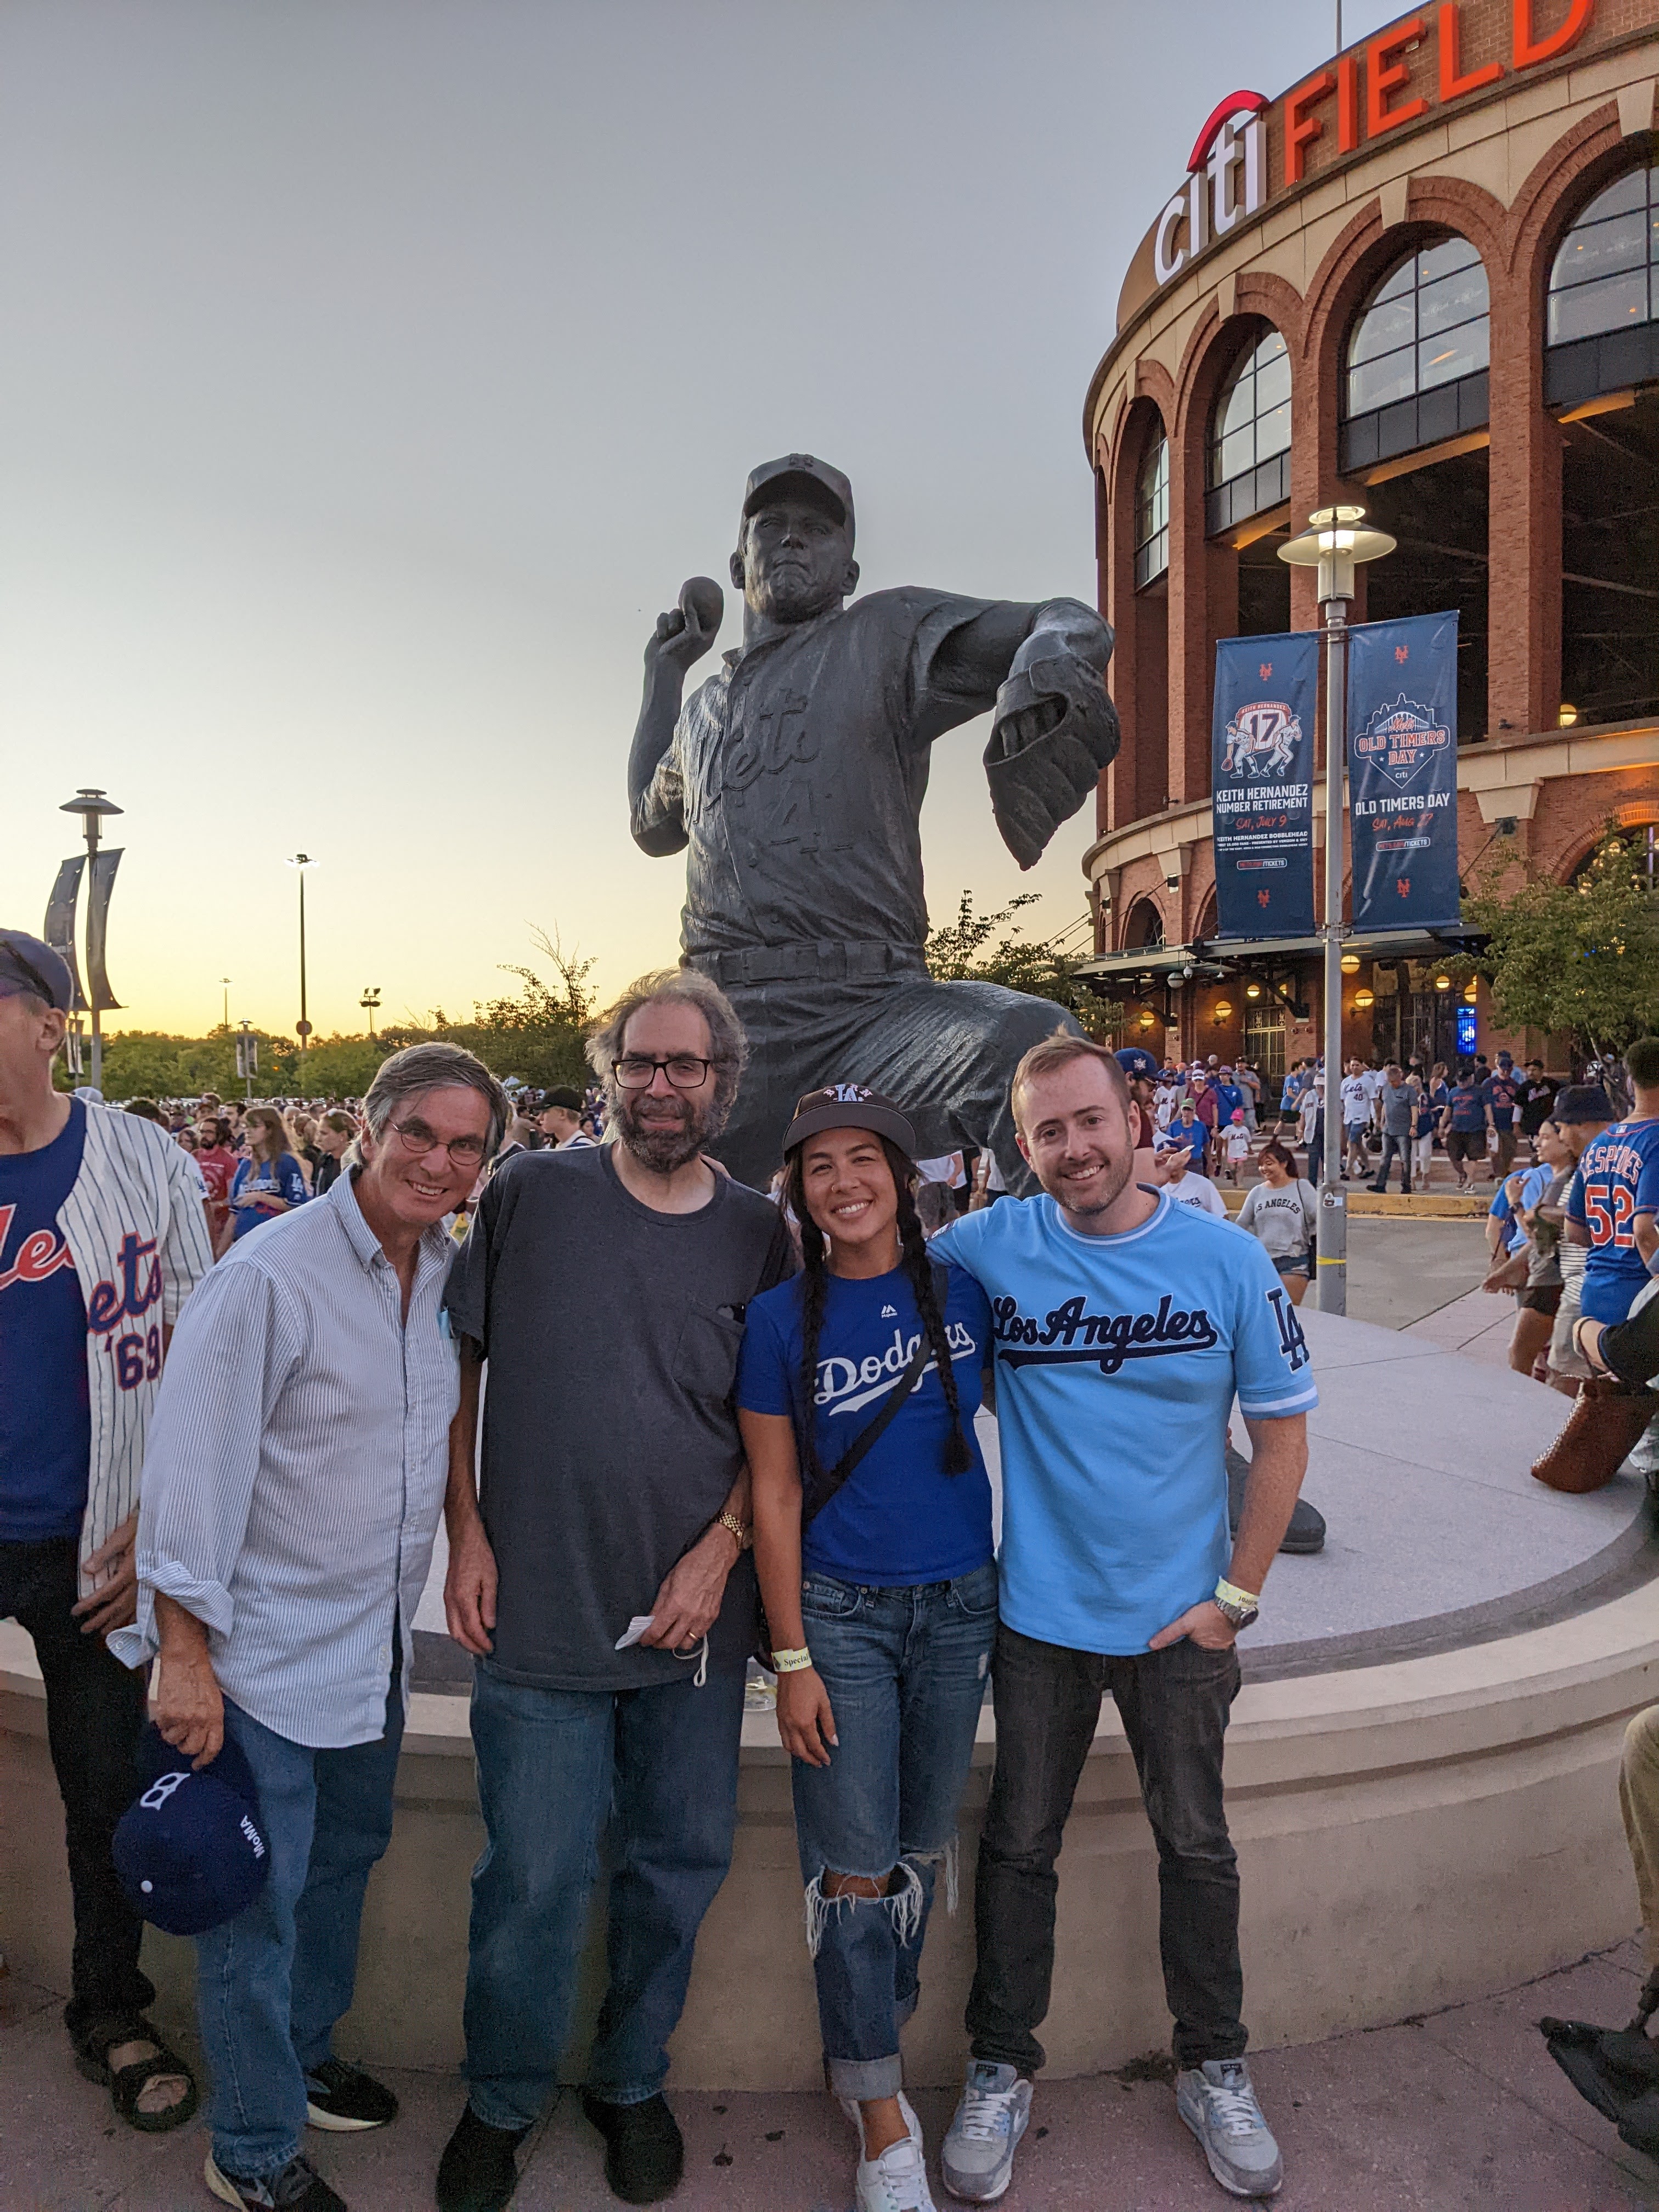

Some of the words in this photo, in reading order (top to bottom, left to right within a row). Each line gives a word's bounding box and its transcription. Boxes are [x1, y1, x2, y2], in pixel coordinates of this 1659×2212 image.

[1155, 120, 1267, 285] citi
[1285, 0, 1595, 188] FIELD
[1250, 713, 1279, 742] 17
[1389, 718, 1415, 731] Mets
[1359, 736, 1386, 752] OLD
[1389, 730, 1446, 749] TIMERS
[1389, 749, 1418, 766] DAY
[1216, 788, 1244, 803] KEITH
[1247, 783, 1308, 800] HERNANDEZ
[1216, 800, 1250, 814] NUMBER
[1252, 797, 1308, 812] RETIREMENT
[1355, 800, 1376, 816] OLD
[1379, 795, 1424, 812] TIMERS
[1427, 793, 1451, 808] DAY
[1278, 814, 1287, 827] 9
[1265, 1198, 1301, 1215] ANGELES
[1585, 1184, 1635, 1248] 52
[991, 1295, 1039, 1344] Los
[1038, 1292, 1218, 1375] Angeles
[1265, 1286, 1311, 1373] LA
[784, 1653, 809, 1667] Special
[140, 1772, 190, 1810] B
[240, 1815, 266, 1859] MoMA
